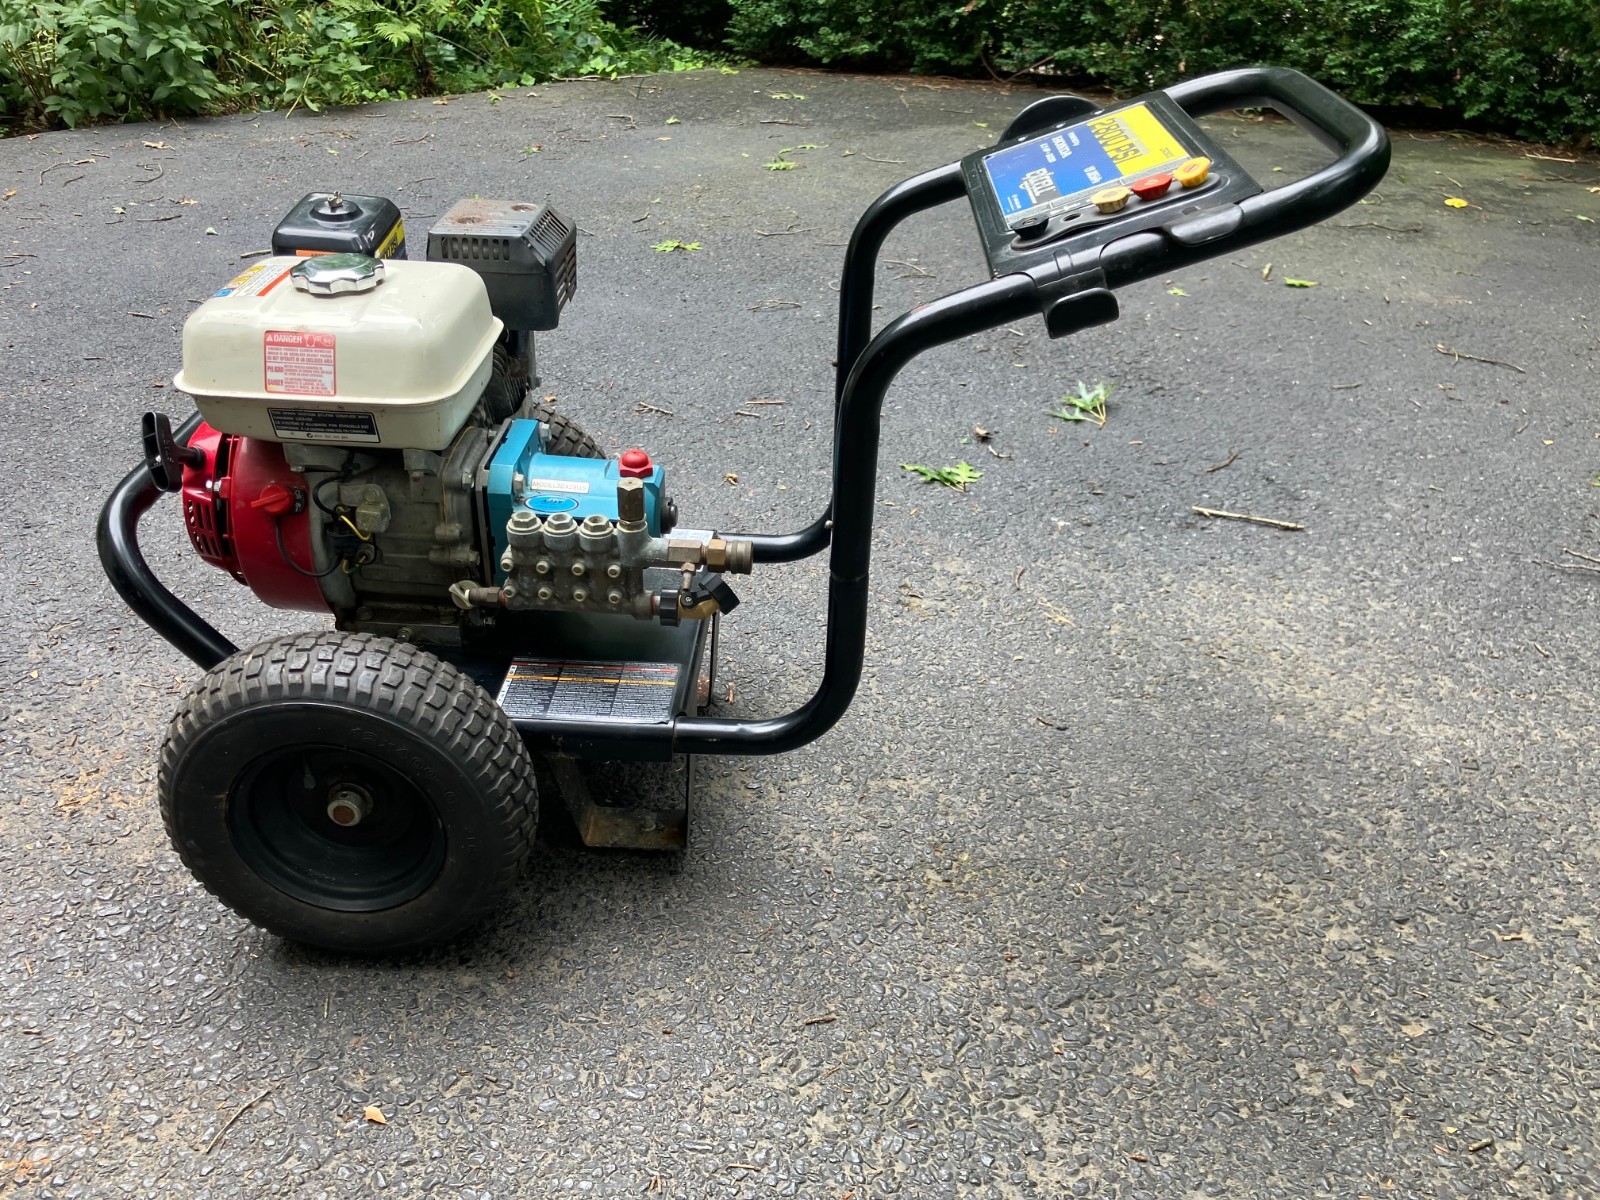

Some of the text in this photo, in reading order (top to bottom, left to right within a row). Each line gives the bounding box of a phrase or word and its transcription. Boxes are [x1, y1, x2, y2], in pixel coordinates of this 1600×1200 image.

[1089, 117, 1131, 149] 2800
[1106, 142, 1143, 164] PSI
[273, 334, 303, 344] DANGER
